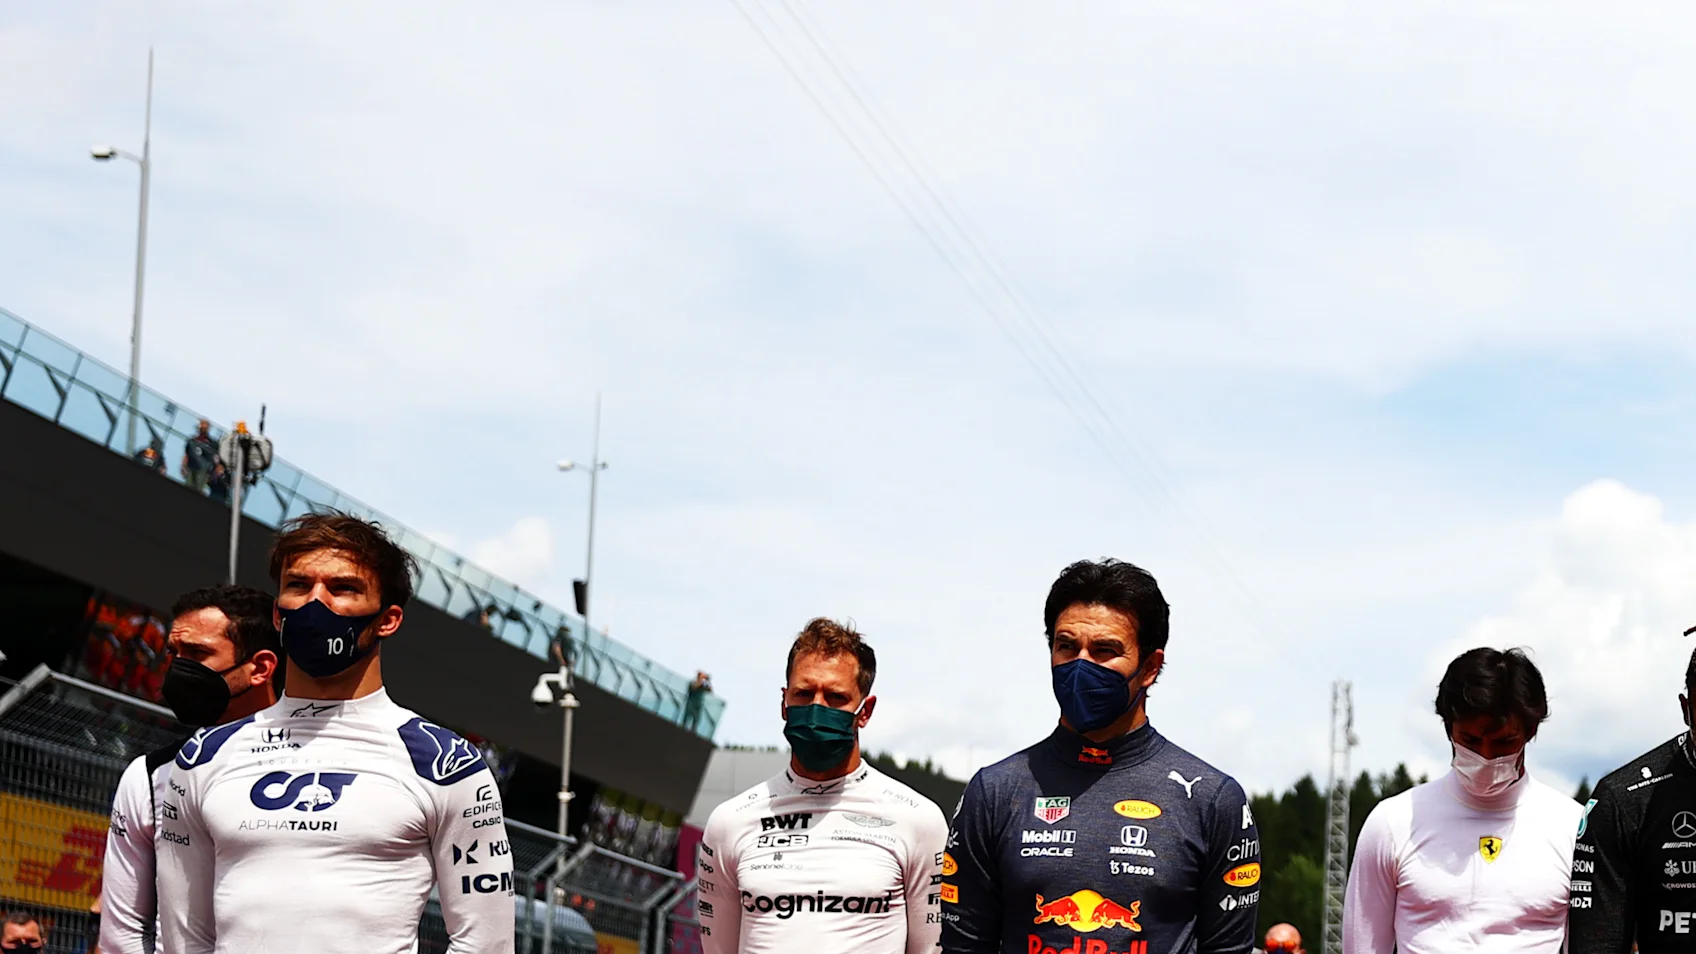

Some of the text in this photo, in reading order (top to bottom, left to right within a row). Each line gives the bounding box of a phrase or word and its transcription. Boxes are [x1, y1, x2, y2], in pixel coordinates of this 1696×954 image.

[327, 638, 343, 655] 10
[251, 742, 301, 754] HONDA
[1040, 798, 1067, 808] TAG
[1037, 808, 1068, 819] HEUER
[1126, 805, 1156, 815] RAUCH
[238, 819, 338, 832] ALPHATAURI
[473, 816, 501, 829] CASIO
[760, 813, 812, 832] BWT
[758, 835, 808, 848] JCB
[1022, 830, 1061, 843] Mobil
[1020, 847, 1074, 857] ORACLE
[1109, 846, 1156, 857] HONDA
[1121, 862, 1155, 876] Tezos
[741, 889, 891, 919] Cognizant
